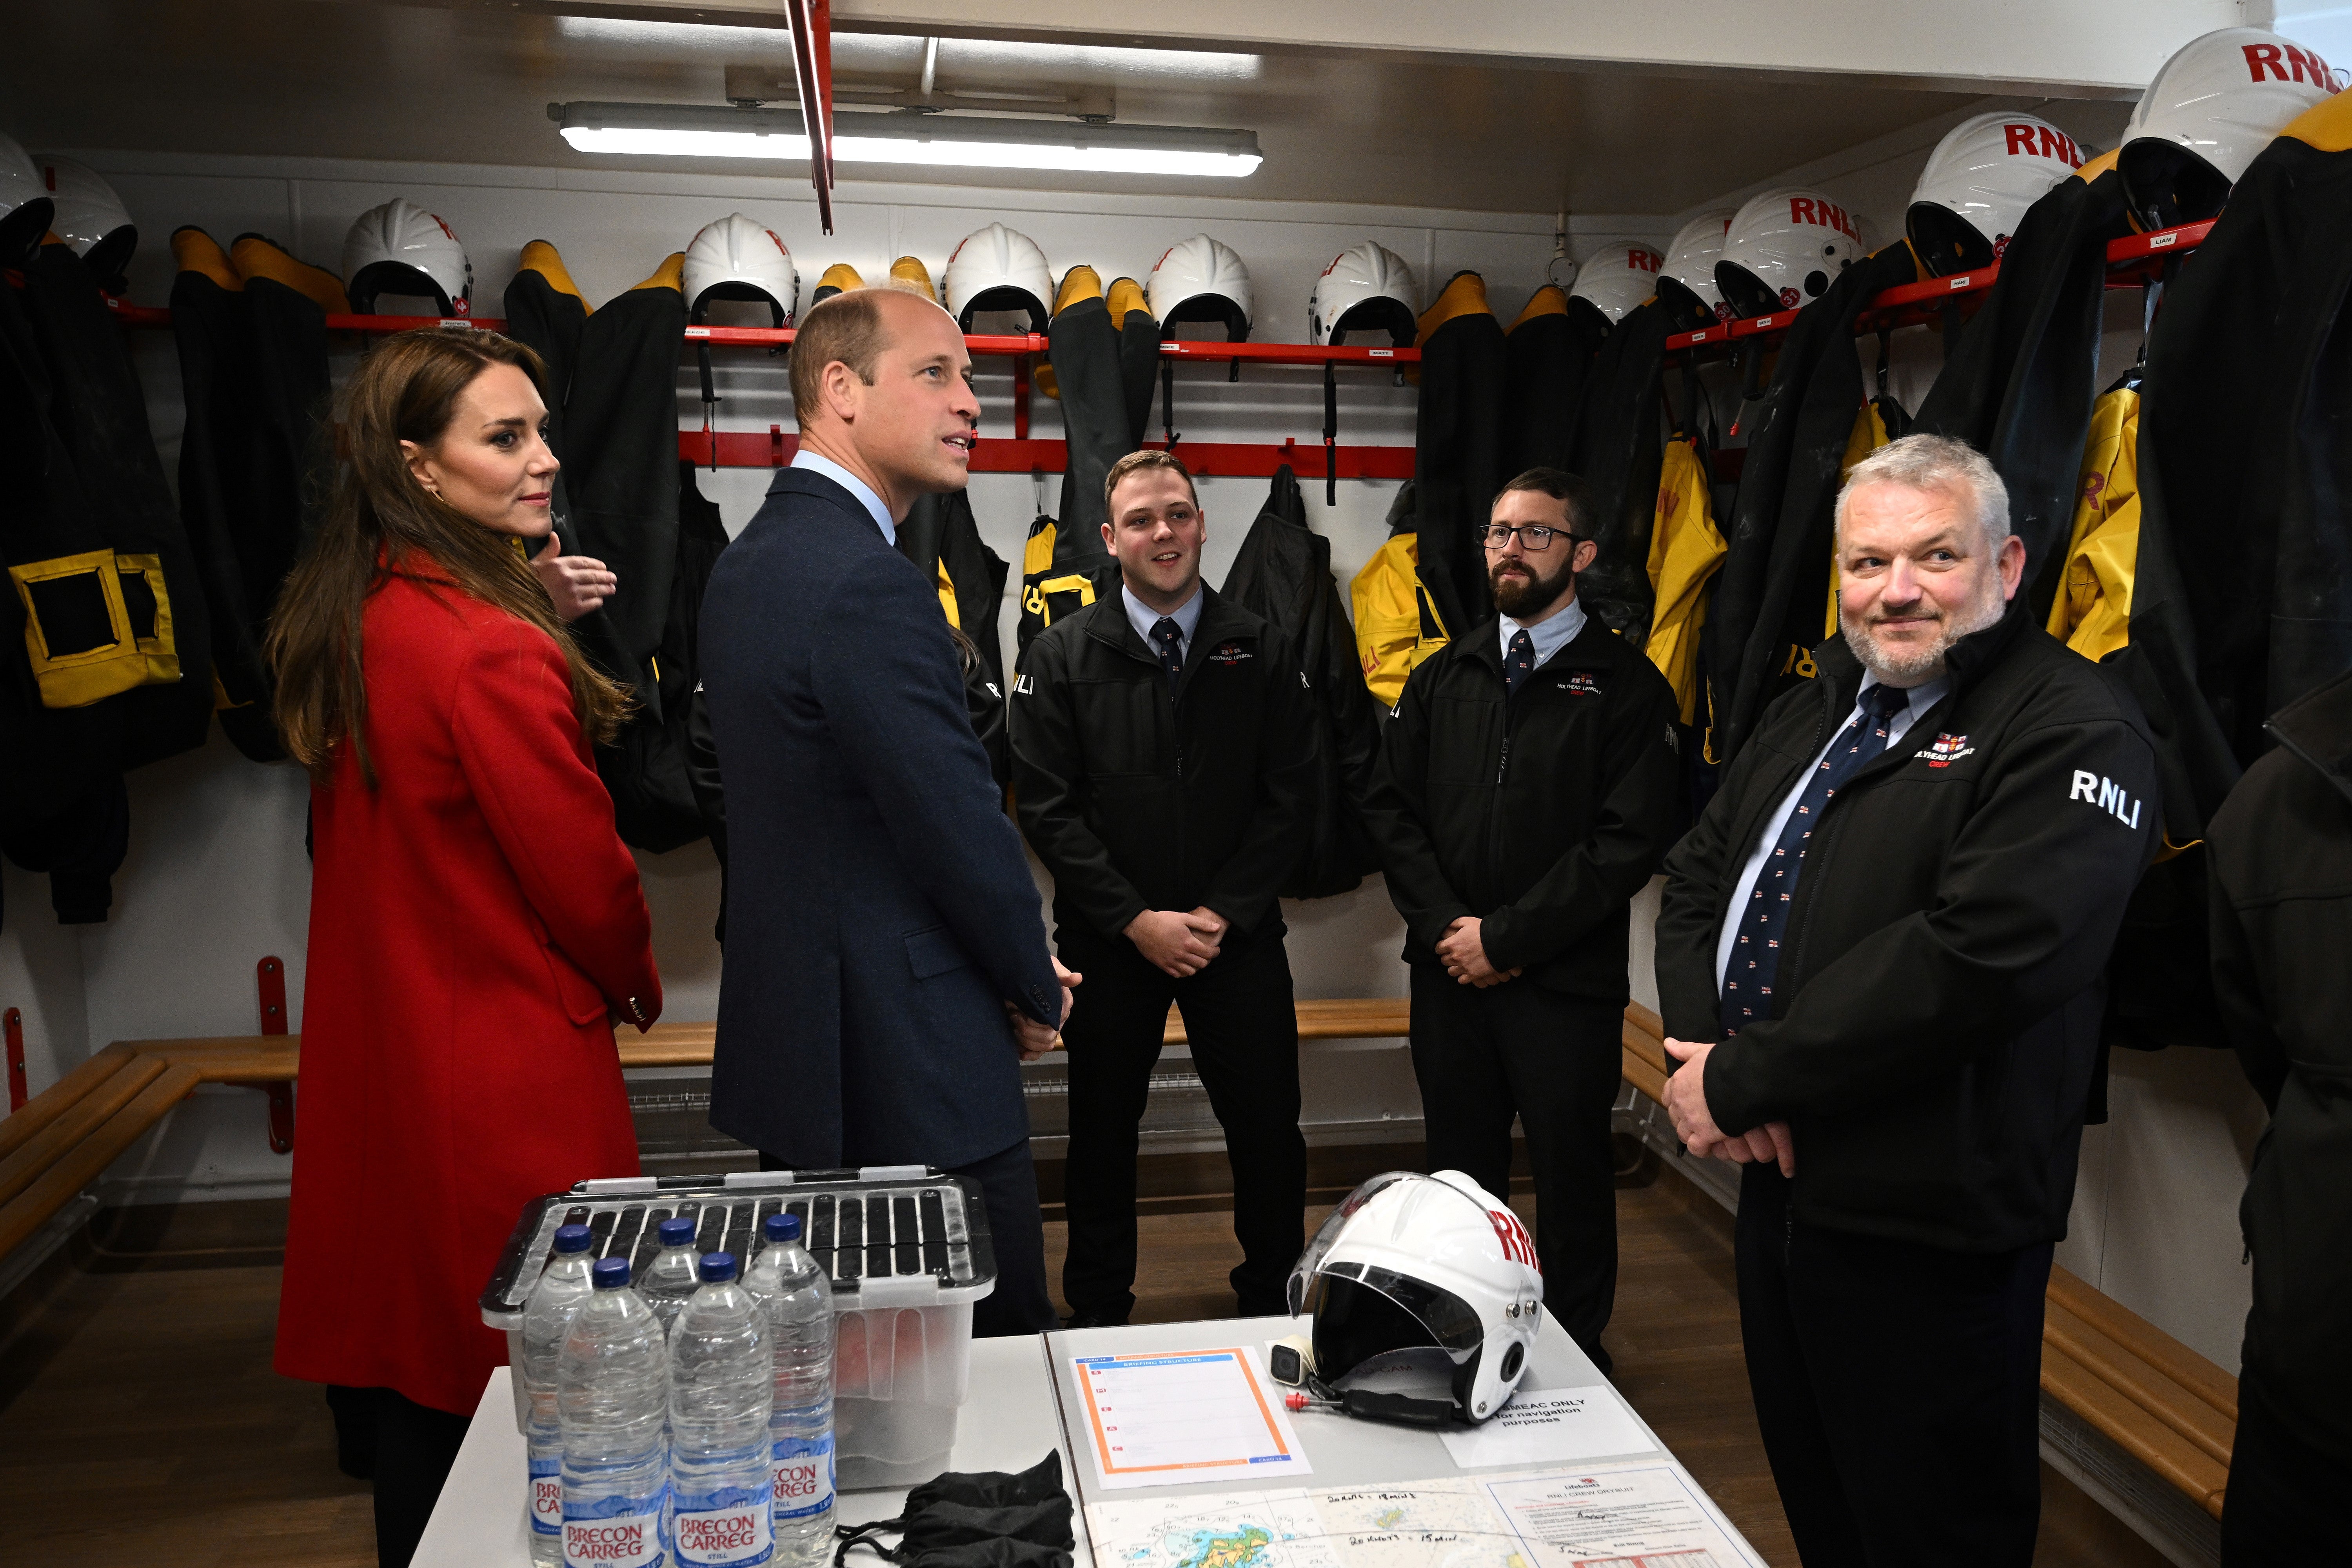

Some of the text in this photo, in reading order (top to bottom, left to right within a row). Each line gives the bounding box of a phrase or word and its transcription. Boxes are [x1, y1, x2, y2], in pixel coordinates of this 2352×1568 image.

[2241, 44, 2342, 94] RNL
[1784, 291, 1797, 305] 31
[1718, 305, 1731, 318] 30
[1582, 686, 1602, 695] LIFEBOAT
[2069, 769, 2141, 829] RNLI
[1502, 1402, 1547, 1411] SMEAC
[1517, 1408, 1581, 1417] navigation
[1502, 1417, 1561, 1427] purposes
[681, 1514, 755, 1535] BRECON
[568, 1524, 643, 1544] BRECON
[680, 1530, 757, 1550] CARREG
[567, 1540, 645, 1560] CARREG
